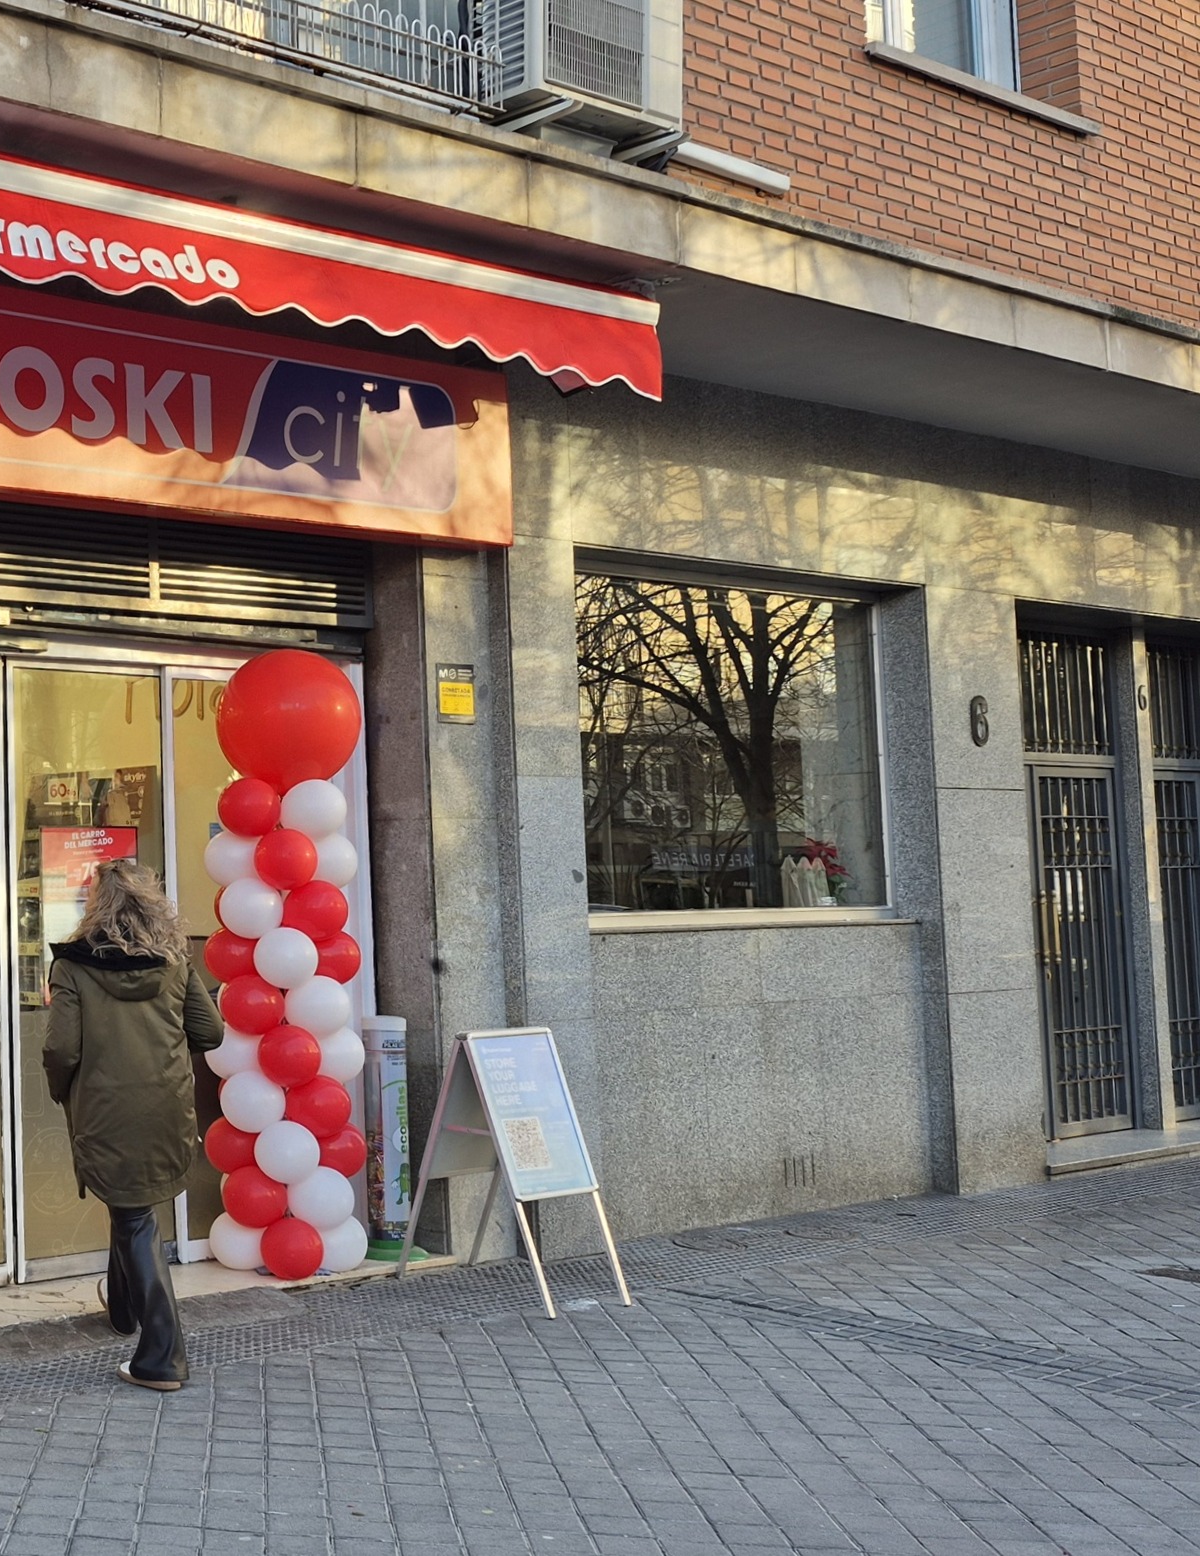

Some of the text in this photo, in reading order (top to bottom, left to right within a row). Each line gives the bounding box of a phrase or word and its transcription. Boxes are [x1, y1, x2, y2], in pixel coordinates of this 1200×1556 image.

[284, 389, 413, 492] city
[1138, 684, 1147, 711] 6
[970, 695, 989, 747] 6
[72, 830, 105, 840] EL CARRO
[64, 837, 113, 849] DEL MERCADO
[484, 1057, 517, 1069] STORE
[487, 1070, 515, 1081] YOUR
[491, 1081, 537, 1094] LUGGAGE
[496, 1095, 522, 1106] HERE
[396, 1085, 408, 1154] ecopilas
